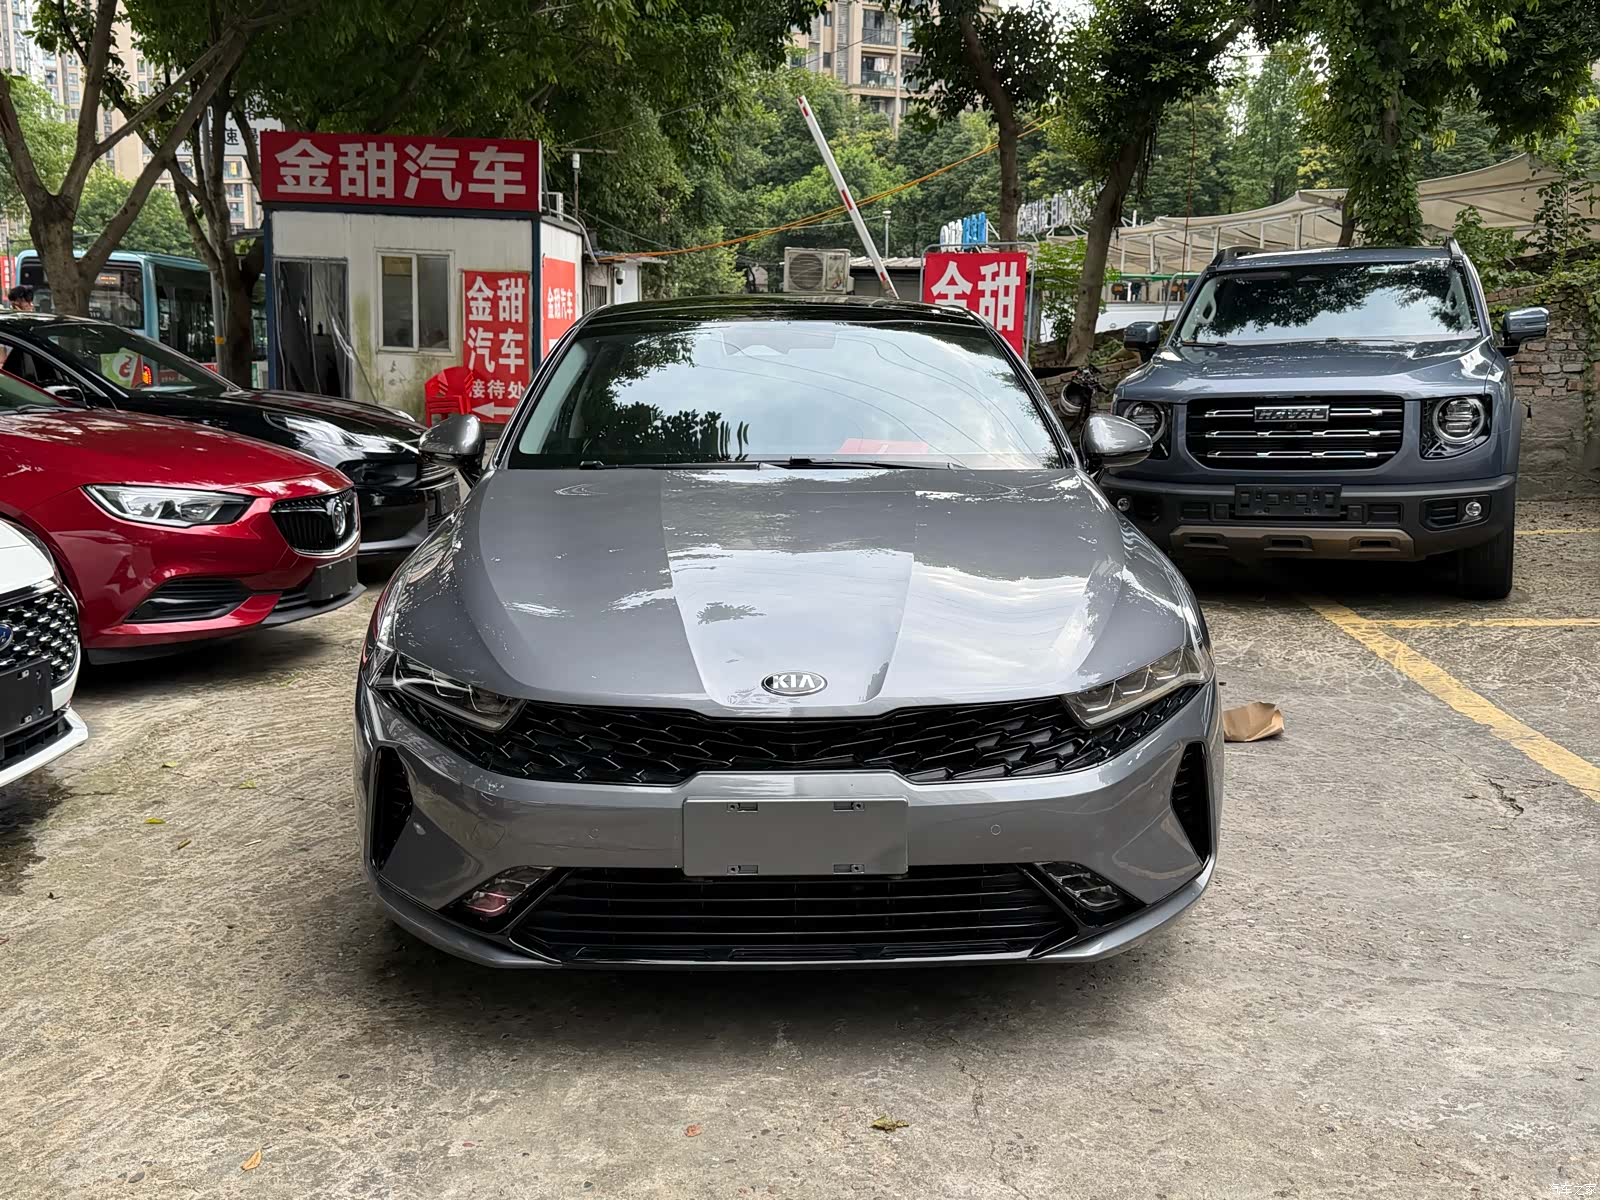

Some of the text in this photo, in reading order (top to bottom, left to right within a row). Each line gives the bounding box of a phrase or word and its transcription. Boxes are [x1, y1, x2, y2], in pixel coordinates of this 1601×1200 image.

[274, 138, 527, 203] 金甜汽车
[466, 276, 526, 323] 金甜
[547, 287, 573, 320] 金甜汽车
[467, 326, 526, 374] 汽车
[469, 379, 526, 399] 接待处
[1259, 408, 1325, 419] HAVAL
[772, 674, 815, 689] KIA
